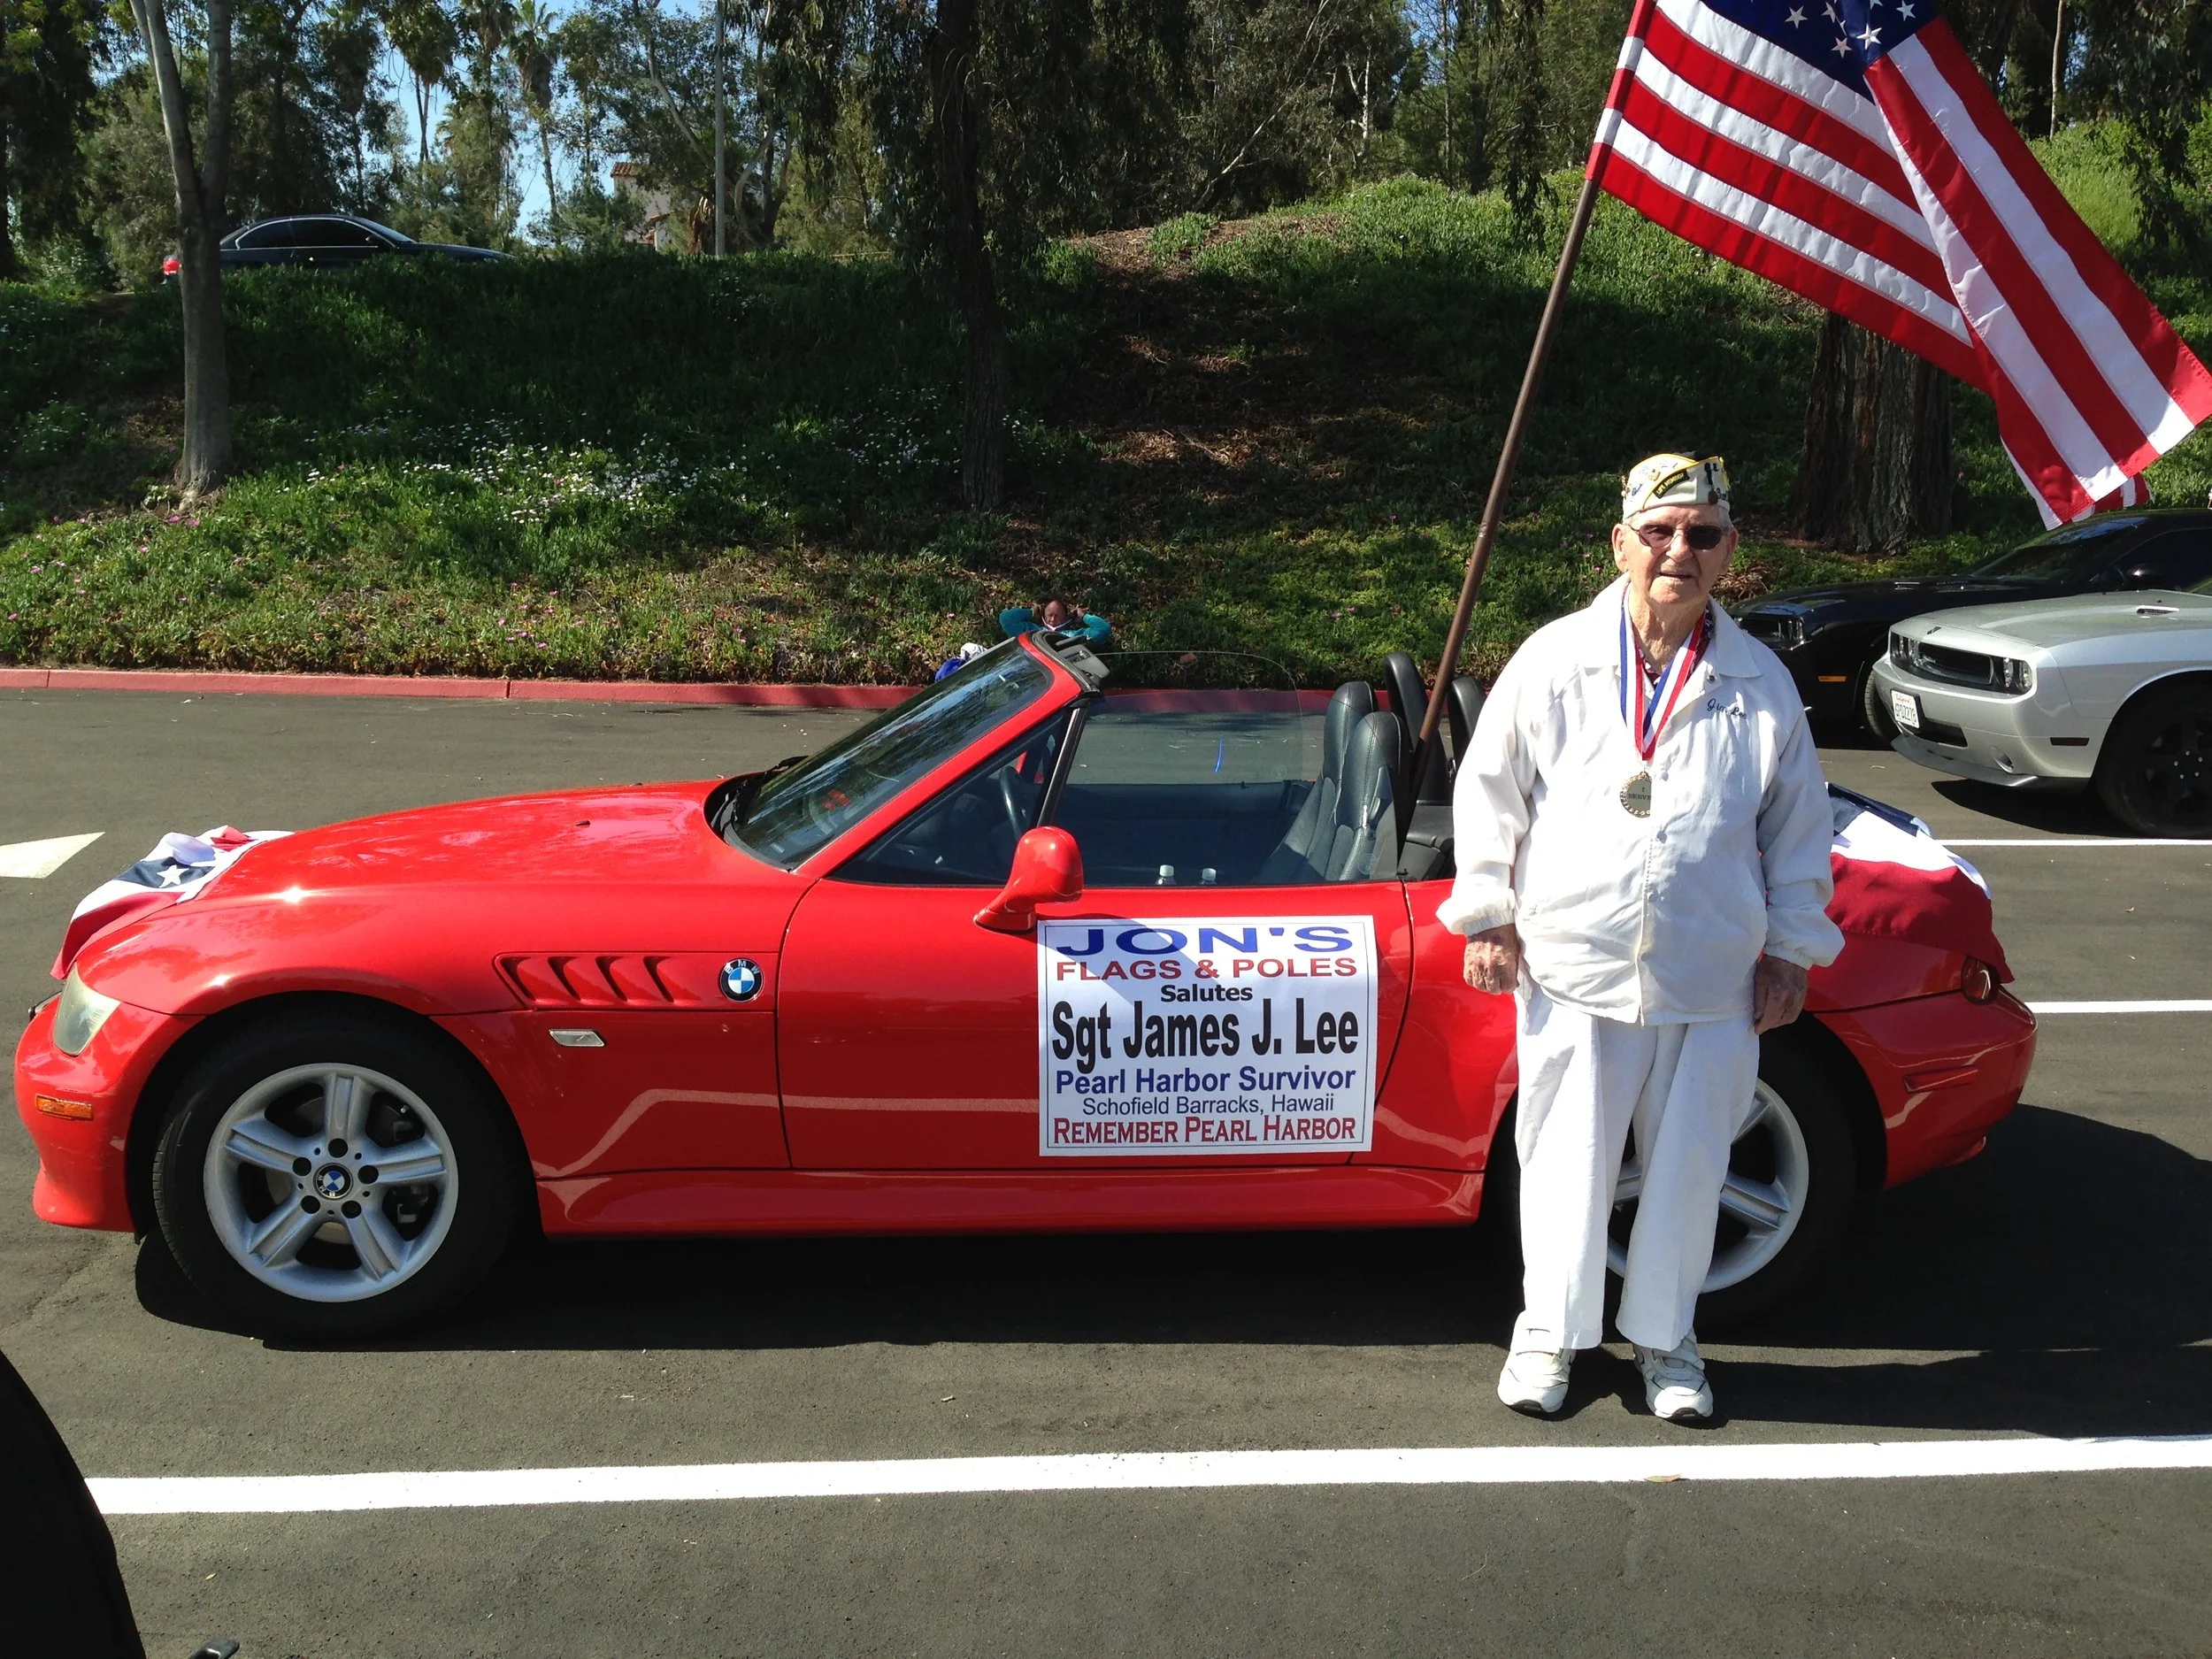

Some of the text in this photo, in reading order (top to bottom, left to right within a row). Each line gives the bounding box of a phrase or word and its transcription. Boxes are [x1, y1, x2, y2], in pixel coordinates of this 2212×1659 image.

[1056, 926, 1354, 956] JON'S
[724, 959, 760, 974] BMW
[1056, 957, 1356, 980] FLAGS & POLES
[1161, 985, 1253, 1002] Salutes
[1052, 998, 1358, 1074] Sgt James J. Lee
[1056, 1064, 1356, 1094] Pearl Harbor Survivor
[1083, 1094, 1333, 1116] Schofield Barracks, Hawaii
